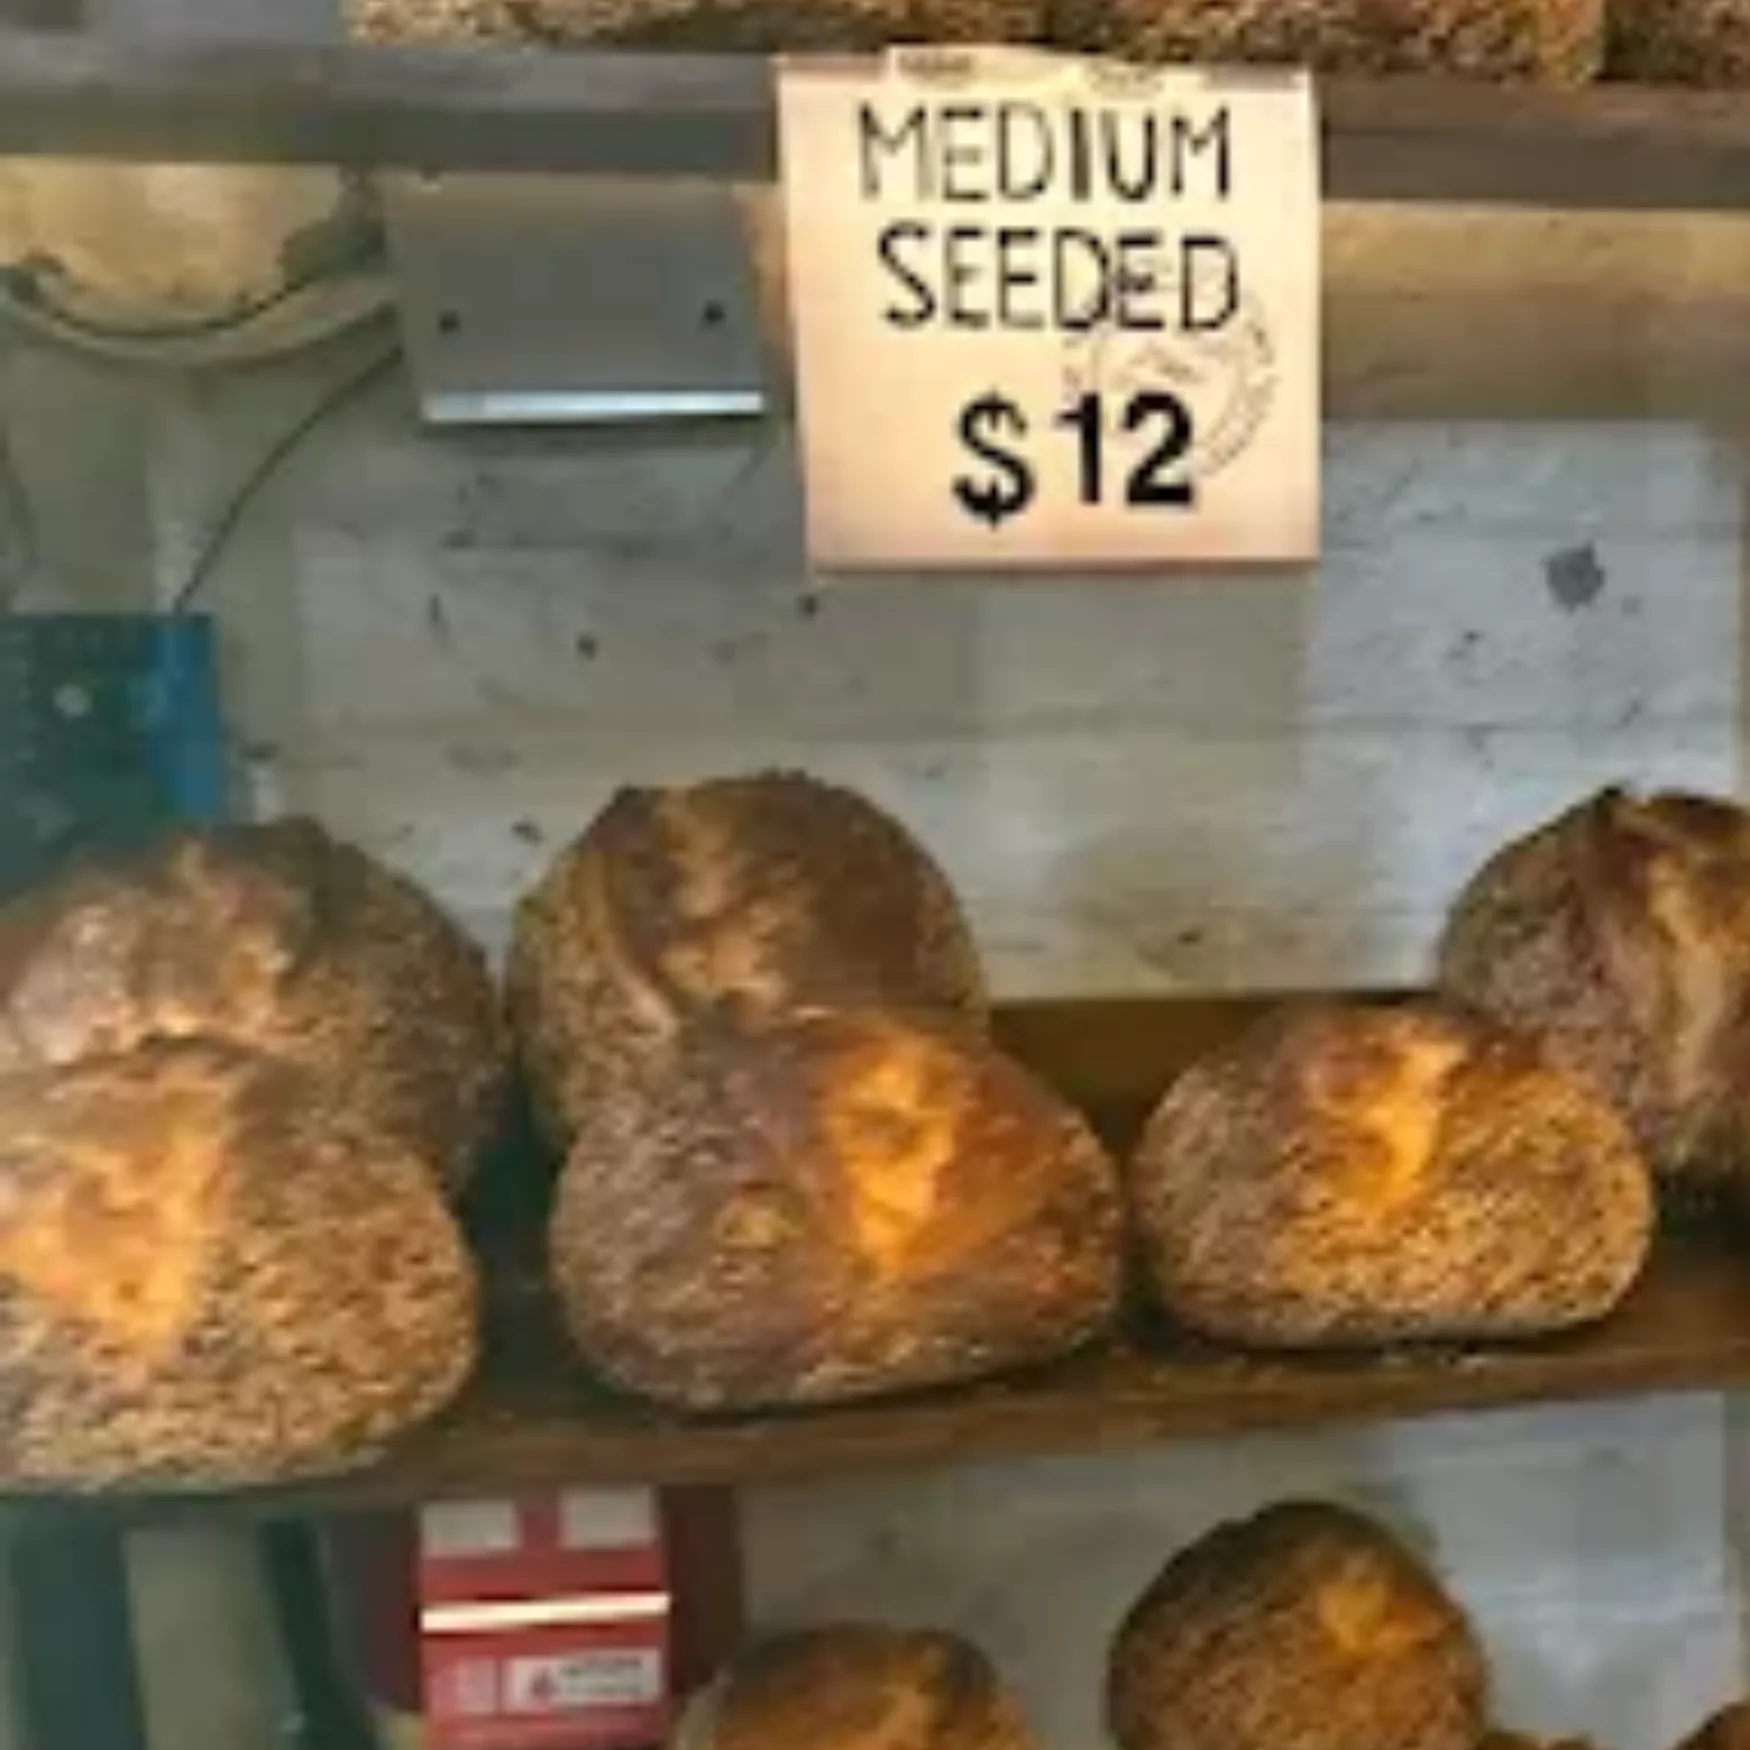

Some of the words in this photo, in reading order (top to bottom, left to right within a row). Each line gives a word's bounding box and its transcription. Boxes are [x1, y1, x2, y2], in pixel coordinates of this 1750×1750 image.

[858, 101, 1231, 201] MEDIUM
[876, 221, 1240, 331] SEEDED
[953, 389, 1195, 530] $12
